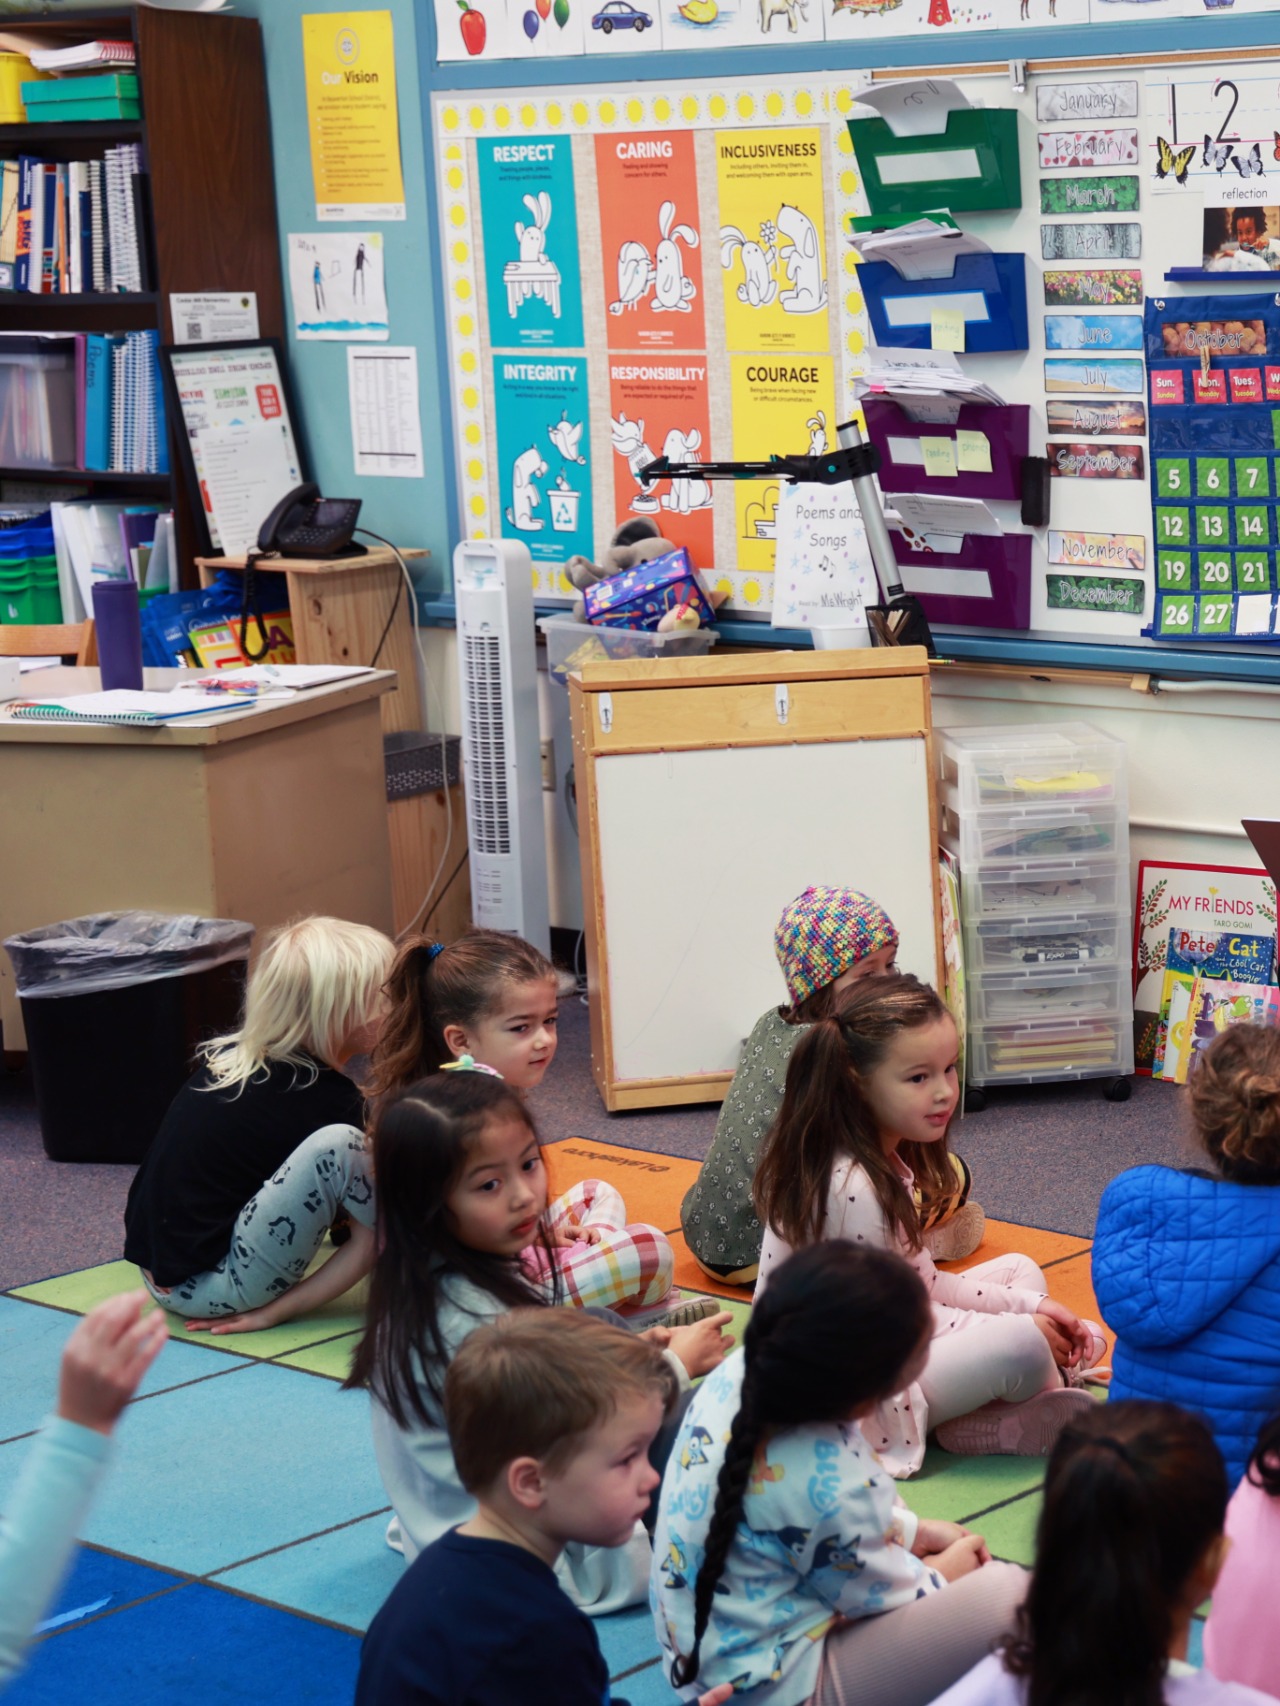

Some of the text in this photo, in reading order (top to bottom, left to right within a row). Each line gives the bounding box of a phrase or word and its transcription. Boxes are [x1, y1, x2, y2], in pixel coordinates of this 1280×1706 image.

[322, 69, 379, 85] Our Vision
[1060, 90, 1118, 114] January
[1215, 81, 1241, 143] 2
[1171, 83, 1178, 145] 1
[493, 144, 555, 163] RESPECT
[616, 141, 673, 159] CARING
[720, 143, 817, 159] INCLUSIVENESS
[1055, 137, 1124, 161] February
[1066, 183, 1116, 206] March
[1222, 188, 1268, 200] reflection
[1075, 230, 1112, 256] April
[1078, 277, 1111, 304] May
[1077, 325, 1113, 345] June
[1185, 329, 1244, 350] October
[87, 344, 103, 389] Poems
[503, 364, 577, 382] INTEGRITY
[611, 366, 706, 381] RESPONSIBILITY
[746, 366, 819, 383] COURAGE
[1080, 367, 1109, 392] July
[1156, 377, 1175, 389] Sun.
[1233, 376, 1255, 388] Tues.
[1156, 391, 1176, 400] Sunday
[1198, 390, 1220, 398] Monday
[1234, 389, 1256, 398] Tuesday
[1072, 408, 1123, 436] August
[1056, 449, 1137, 478] September
[1168, 469, 1180, 490] 5
[1207, 468, 1220, 489] 6
[1246, 468, 1259, 488] 7
[796, 504, 836, 520] Poems
[1162, 516, 1184, 537] 12
[1202, 516, 1223, 537] 13
[1241, 516, 1264, 537] 14
[809, 533, 847, 551] Songs
[1061, 538, 1134, 561] November
[1164, 561, 1185, 581] 19
[1204, 561, 1229, 583] 20
[1242, 562, 1265, 583] 21
[1059, 579, 1134, 606] December
[1164, 604, 1190, 625] 26
[1204, 604, 1229, 625] 27
[1168, 896, 1254, 916] MY FRIENDS
[1213, 920, 1253, 929] TARO GOMI
[1180, 932, 1216, 953] Pete
[1229, 937, 1261, 957] Cat
[1046, 952, 1065, 960] EXPO
[1229, 960, 1247, 968] Cool
[1250, 962, 1264, 972] Cat
[1232, 969, 1261, 982] Boogie
